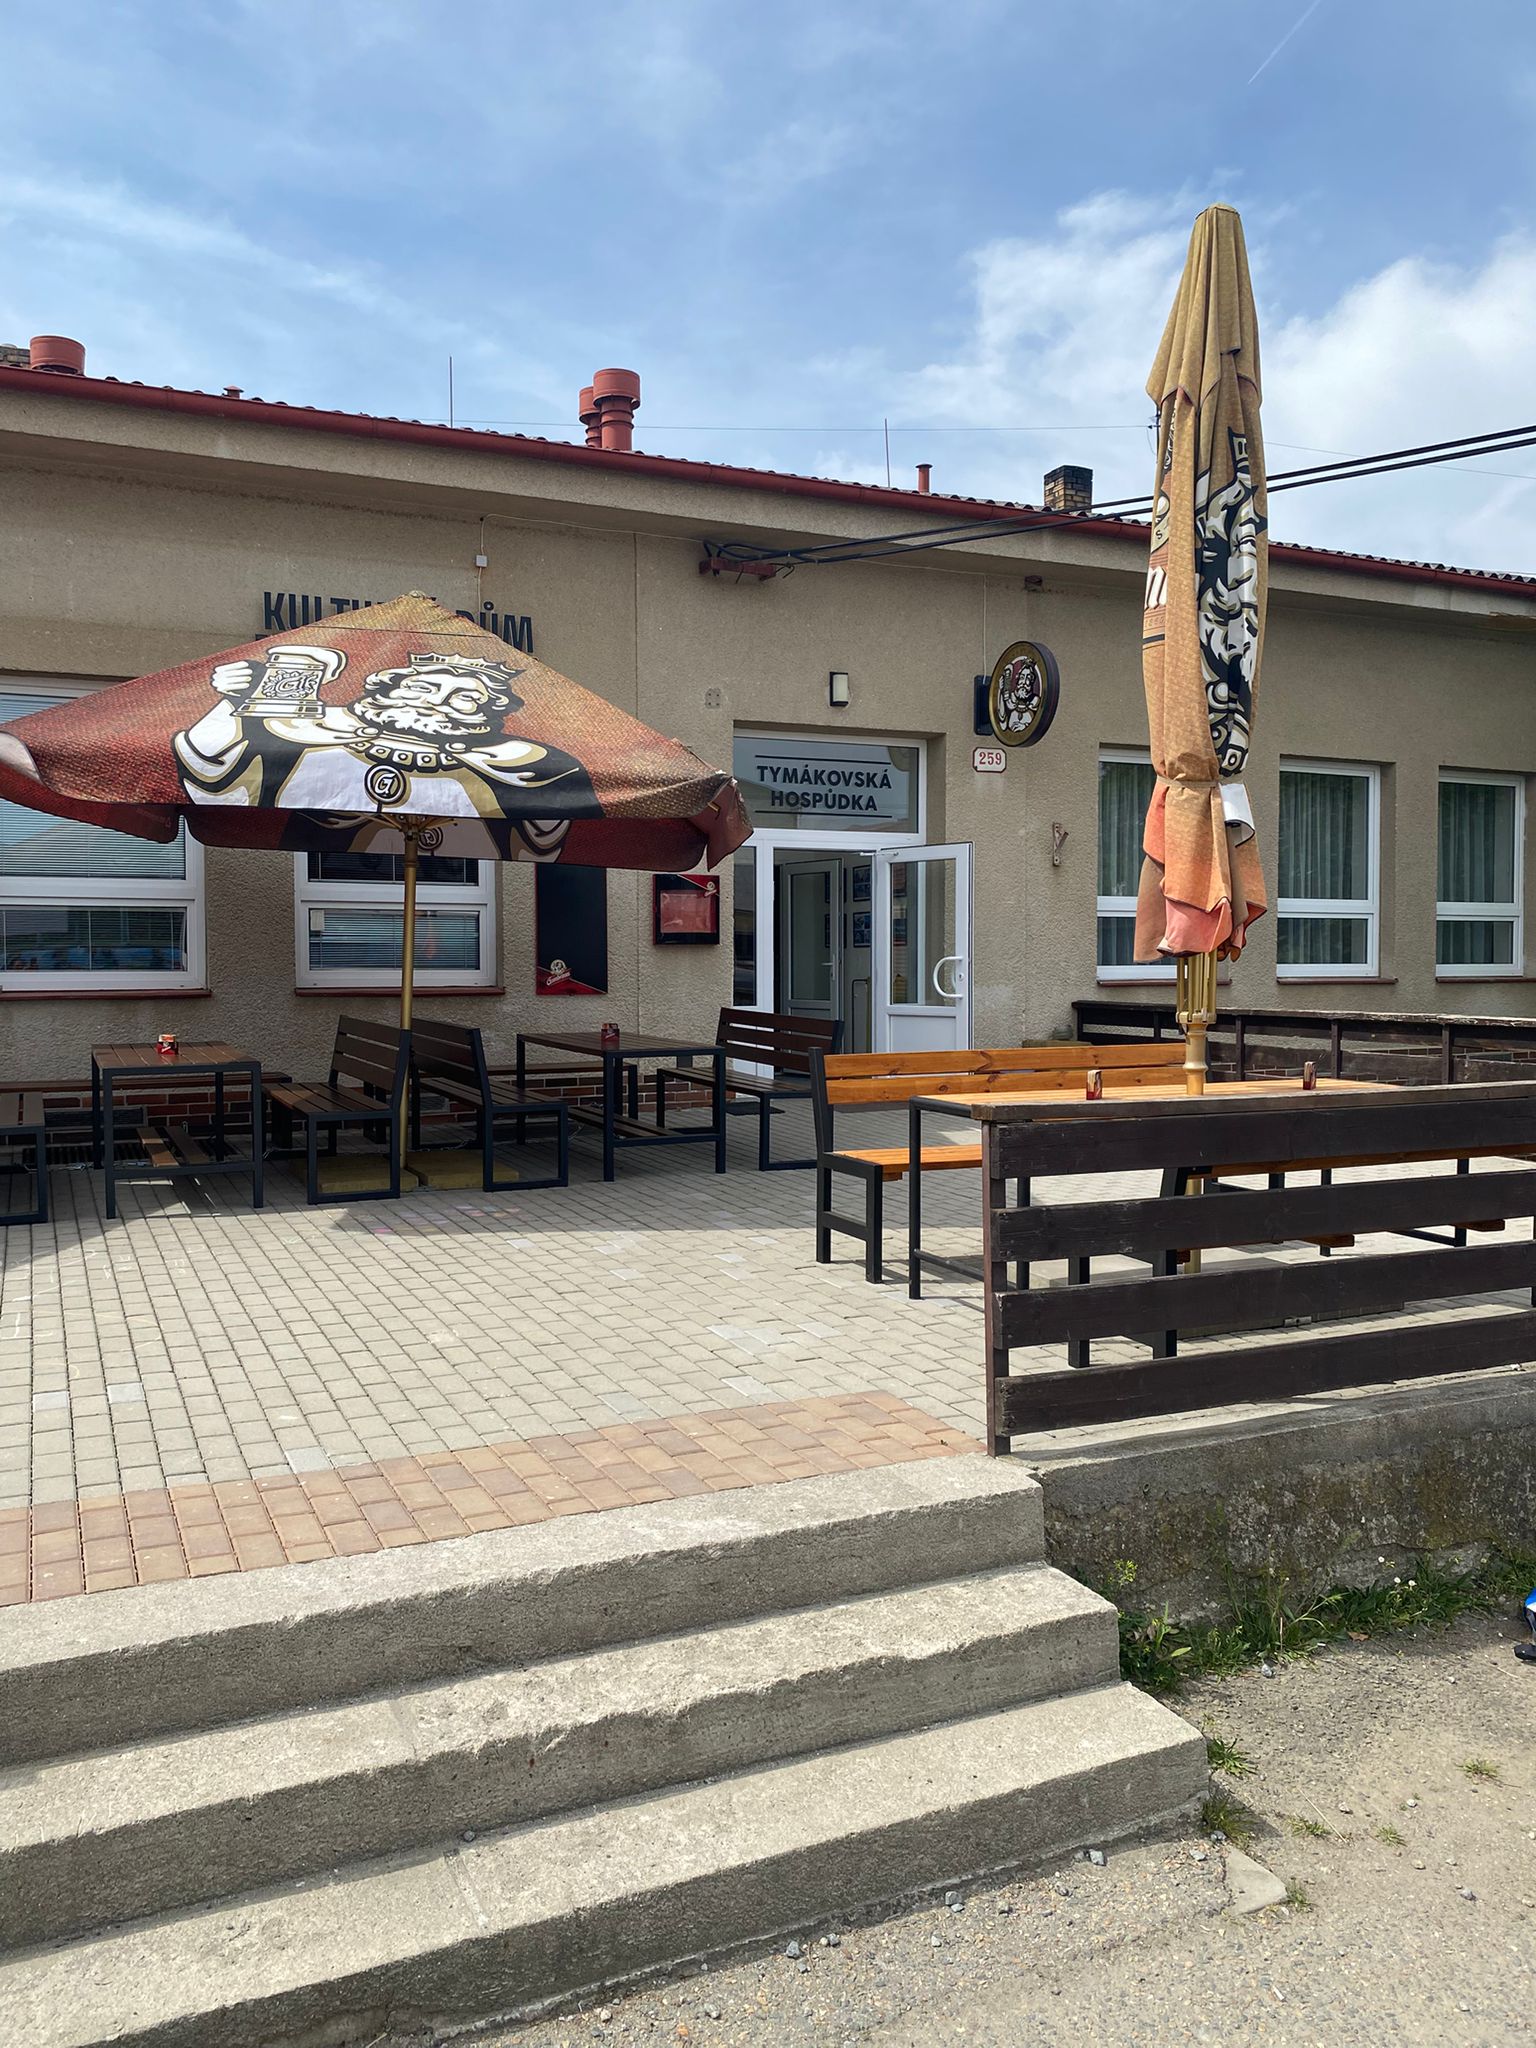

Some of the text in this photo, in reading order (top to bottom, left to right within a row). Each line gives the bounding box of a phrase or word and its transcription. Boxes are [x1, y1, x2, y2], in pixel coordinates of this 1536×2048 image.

[455, 601, 534, 653] ŮM
[979, 752, 1002, 766] 259
[757, 764, 892, 789] TYMÁKOVSKÁ
[771, 788, 878, 812] HOSPŮDKA
